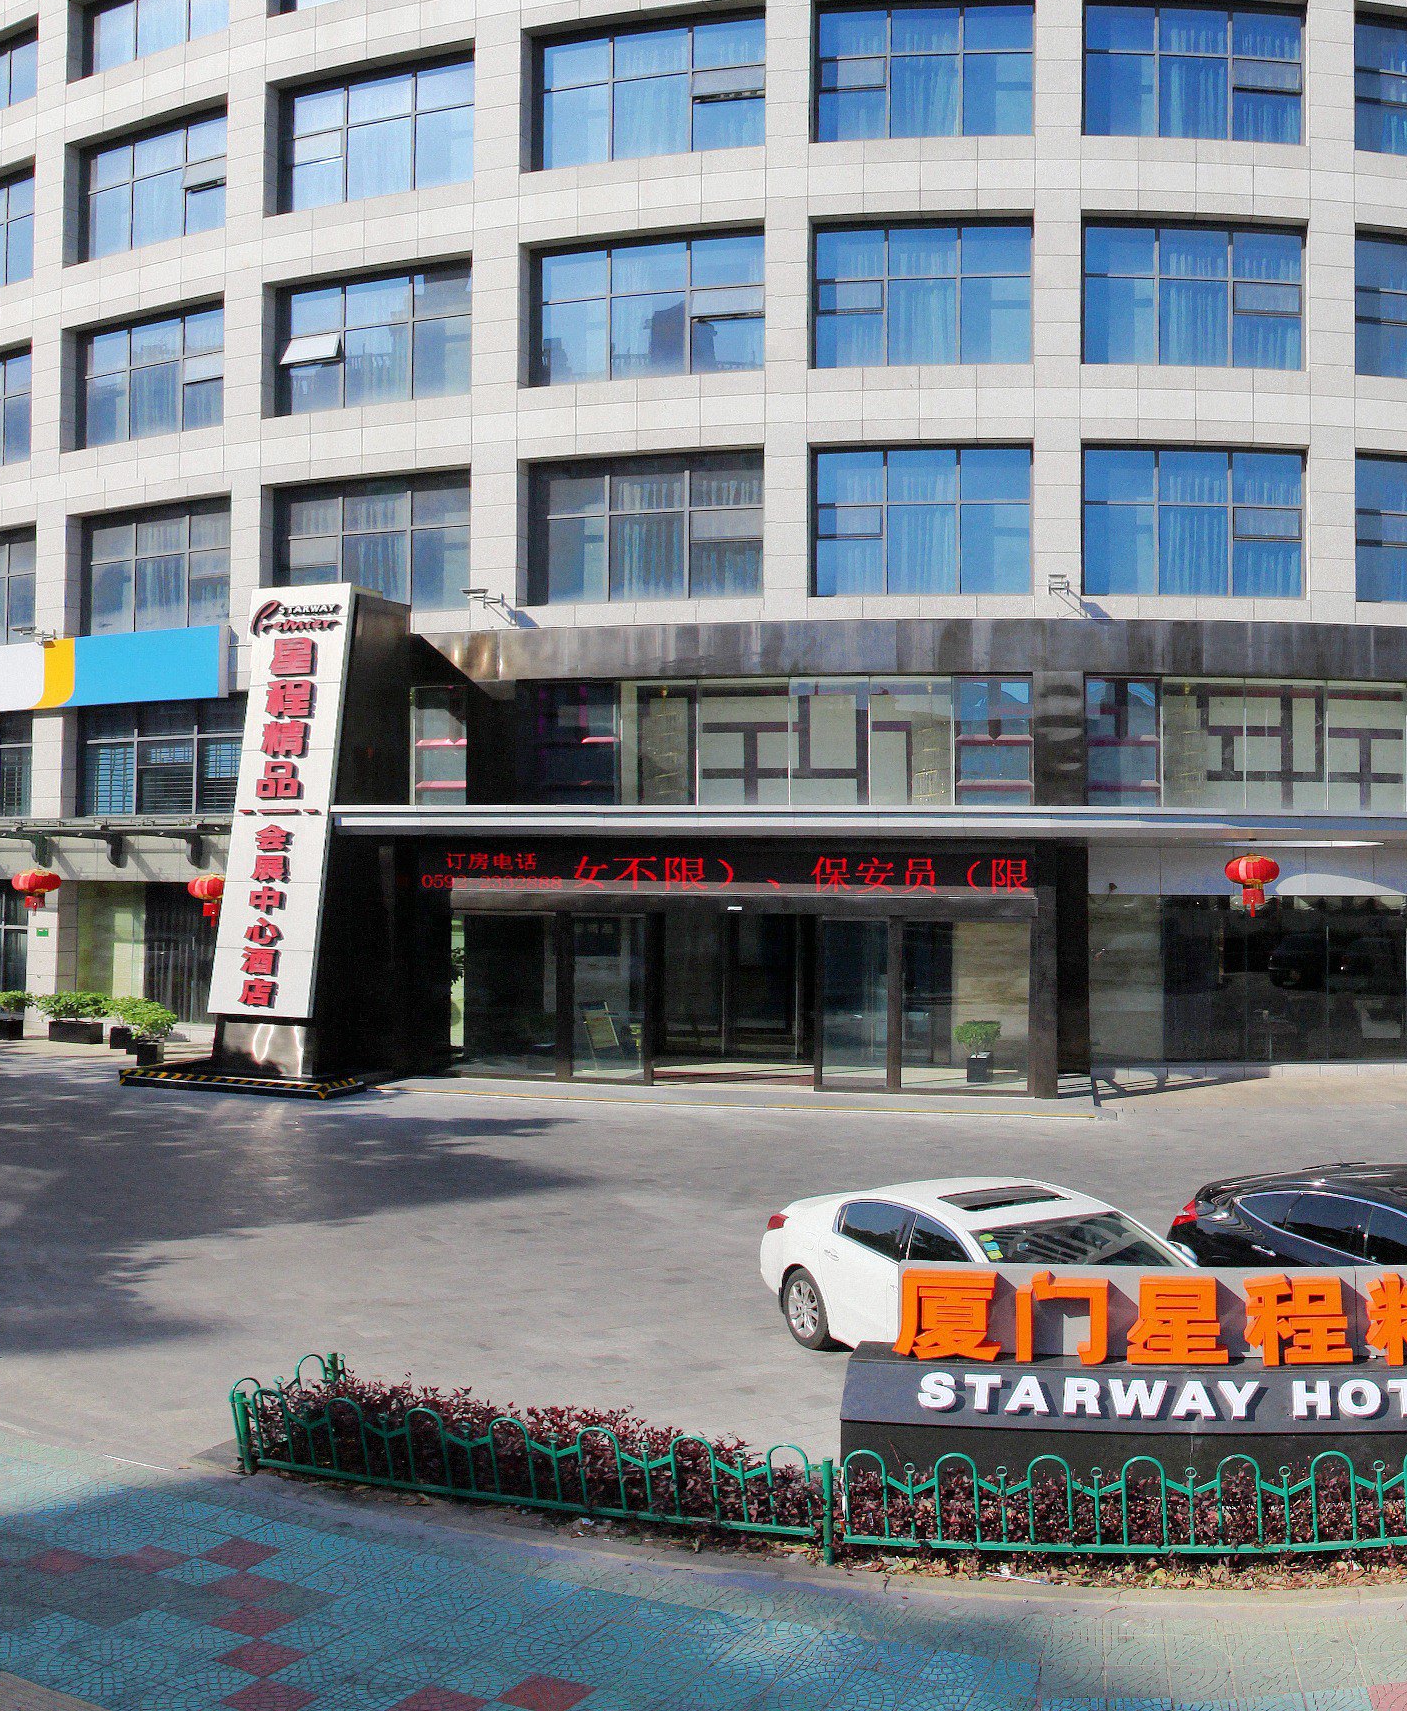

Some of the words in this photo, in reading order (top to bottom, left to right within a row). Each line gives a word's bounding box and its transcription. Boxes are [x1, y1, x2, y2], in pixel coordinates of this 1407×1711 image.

[278, 604, 341, 615] STARWAY
[255, 637, 317, 799] 星程精品
[445, 852, 538, 871] 订房电话
[238, 824, 296, 1008] 会展中心酒店
[918, 1370, 1261, 1421] STARWAY
